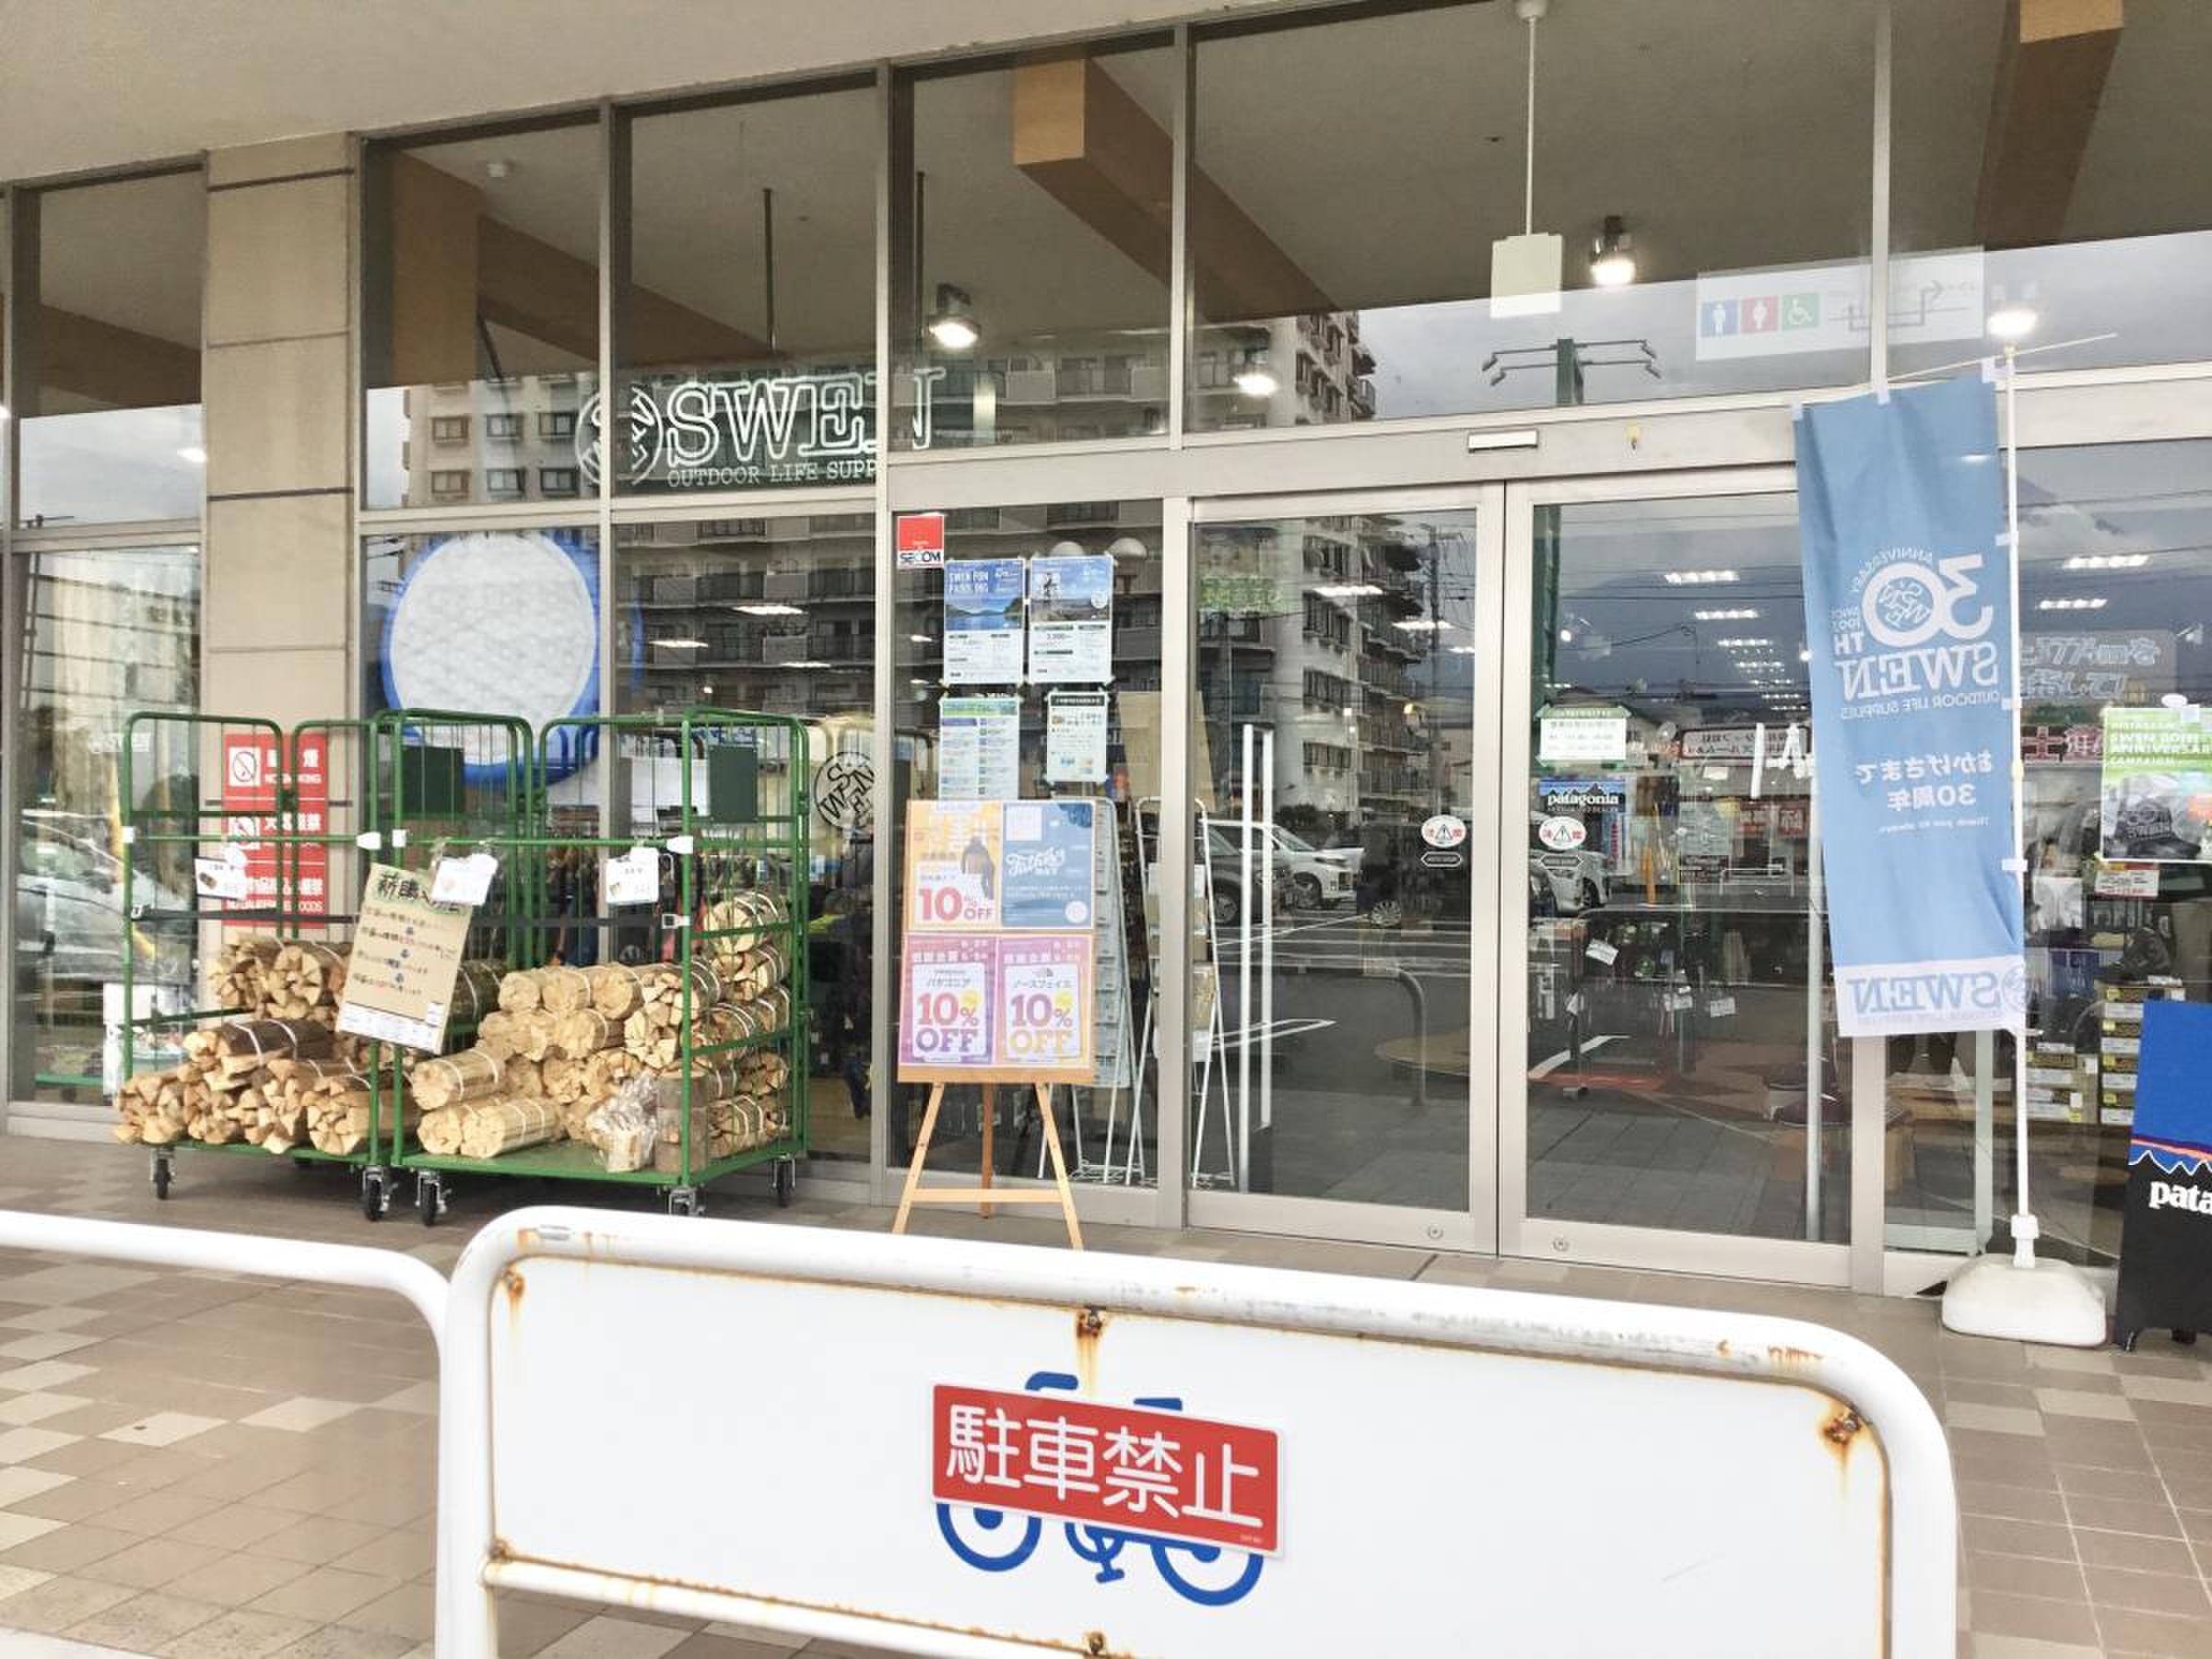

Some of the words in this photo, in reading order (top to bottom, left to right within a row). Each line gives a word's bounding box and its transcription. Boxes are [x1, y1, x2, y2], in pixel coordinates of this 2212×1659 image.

[667, 467, 759, 488] OUTDOOR
[771, 464, 818, 483] LIFE
[1547, 793, 1619, 807] patagonia
[963, 908, 993, 921] OFF
[917, 992, 980, 1027] 10%
[1010, 993, 1073, 1028] 10%
[915, 1027, 979, 1053] OFF
[1008, 1028, 1073, 1055] OFF
[946, 1404, 1264, 1529] 駐車禁止
